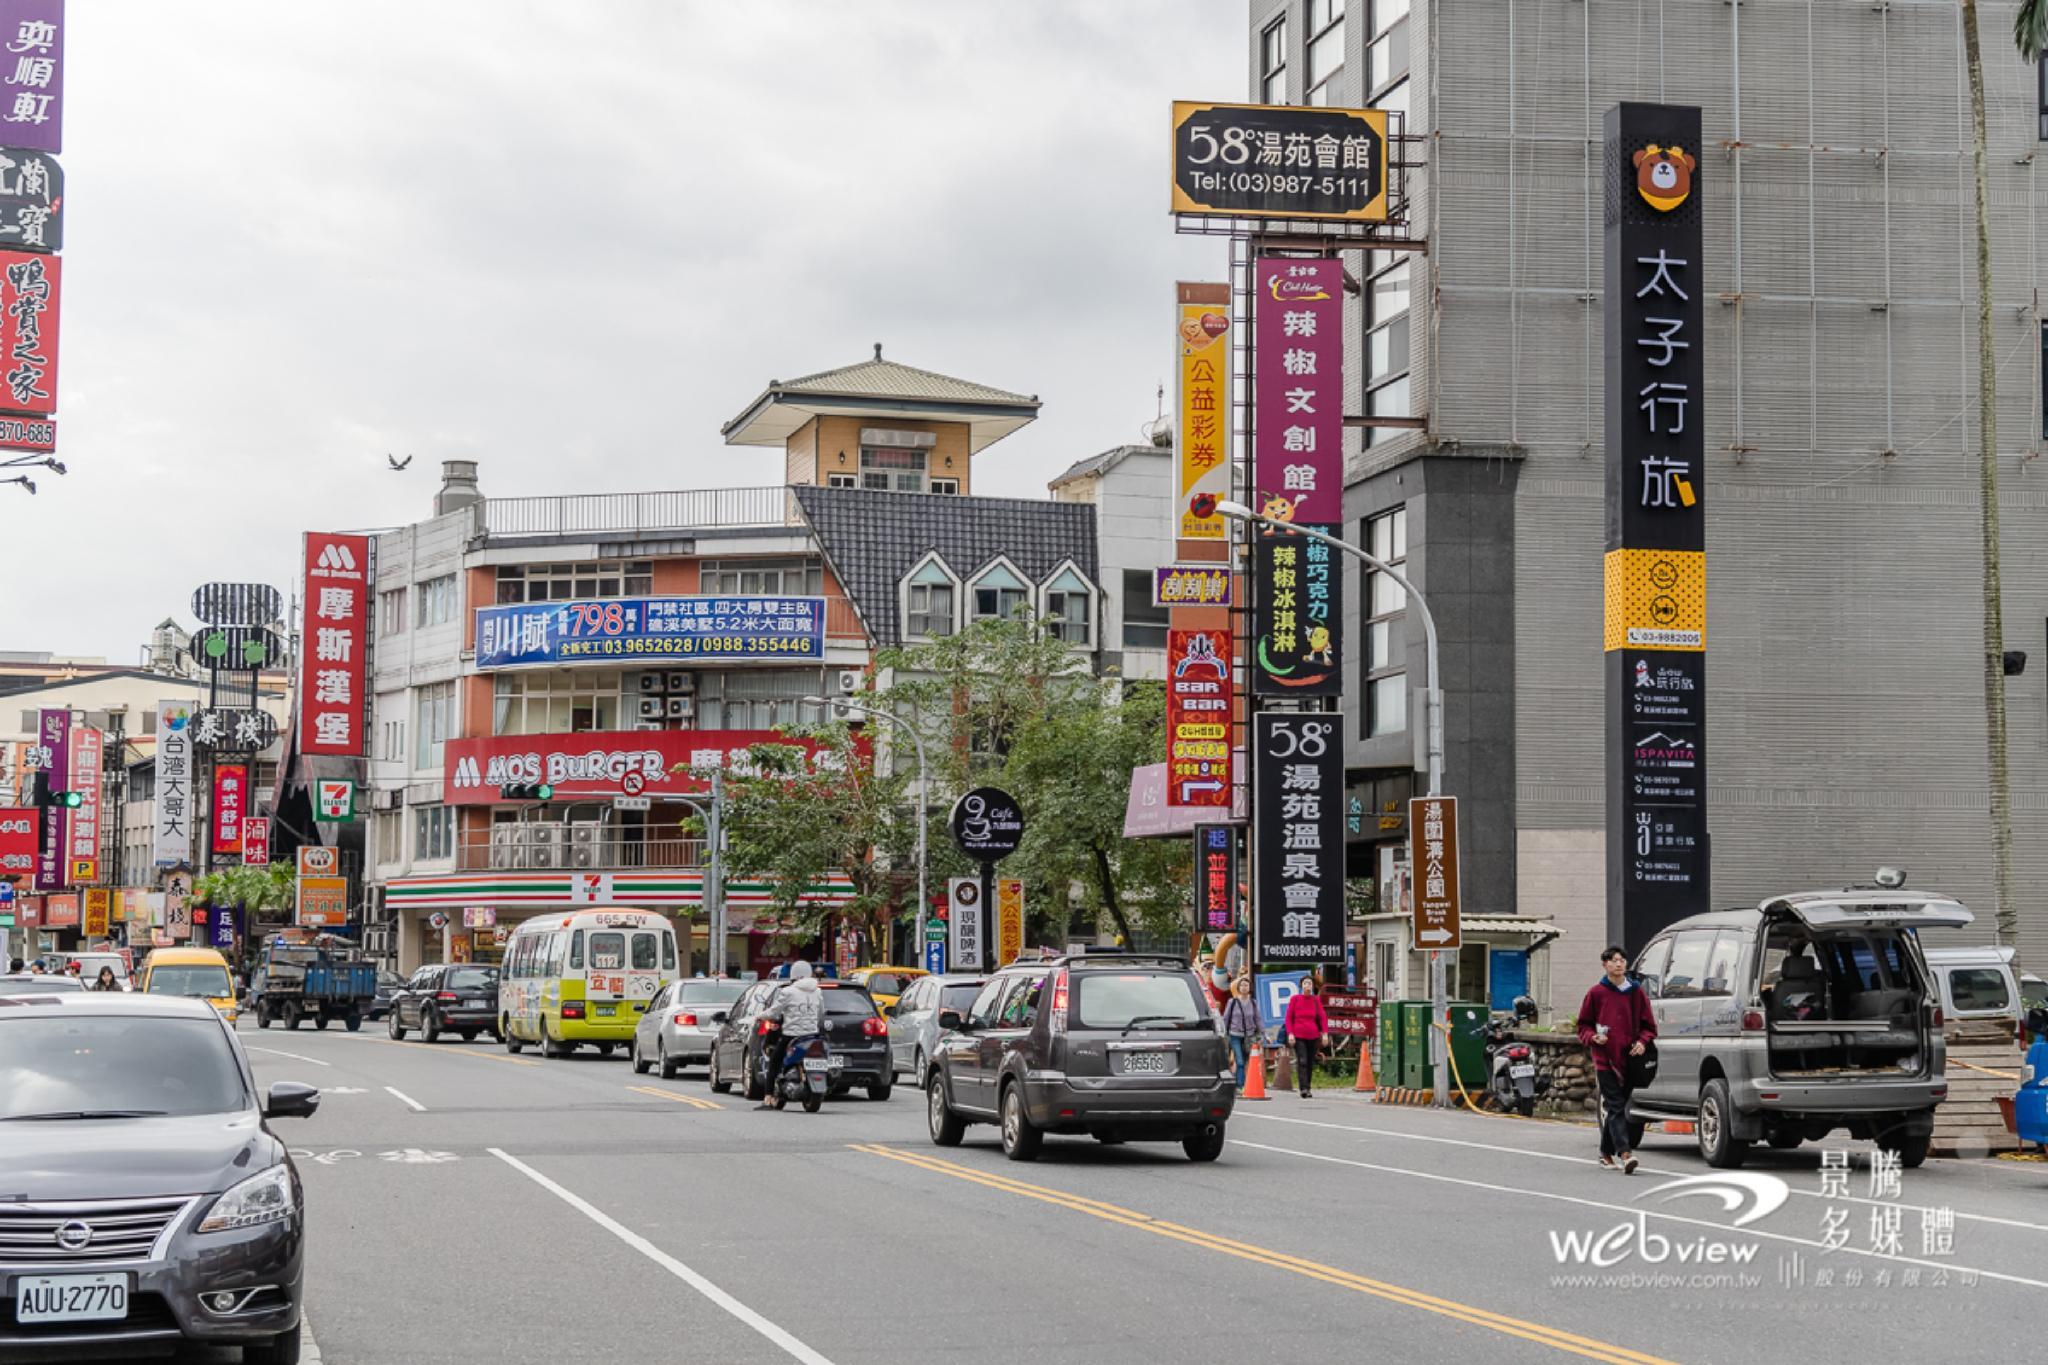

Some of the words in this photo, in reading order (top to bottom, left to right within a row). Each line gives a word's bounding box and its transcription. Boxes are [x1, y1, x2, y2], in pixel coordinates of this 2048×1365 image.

[4, 20, 56, 125] 奕順軒
[8, 258, 49, 404] 鴨賞之家
[1636, 248, 1696, 507] 太子行旅
[1190, 359, 1216, 467] 公益彩券
[1283, 311, 1317, 490] 辣椒文創館
[569, 603, 624, 637] 798
[1273, 545, 1296, 653] 辣椒冰淇淋
[315, 587, 353, 745] 摩斯漢堡
[484, 752, 539, 787] MOS
[245, 820, 266, 862] 滷味
[1281, 764, 1322, 939] 湯苑溫泉會館
[1269, 980, 1299, 1018] P
